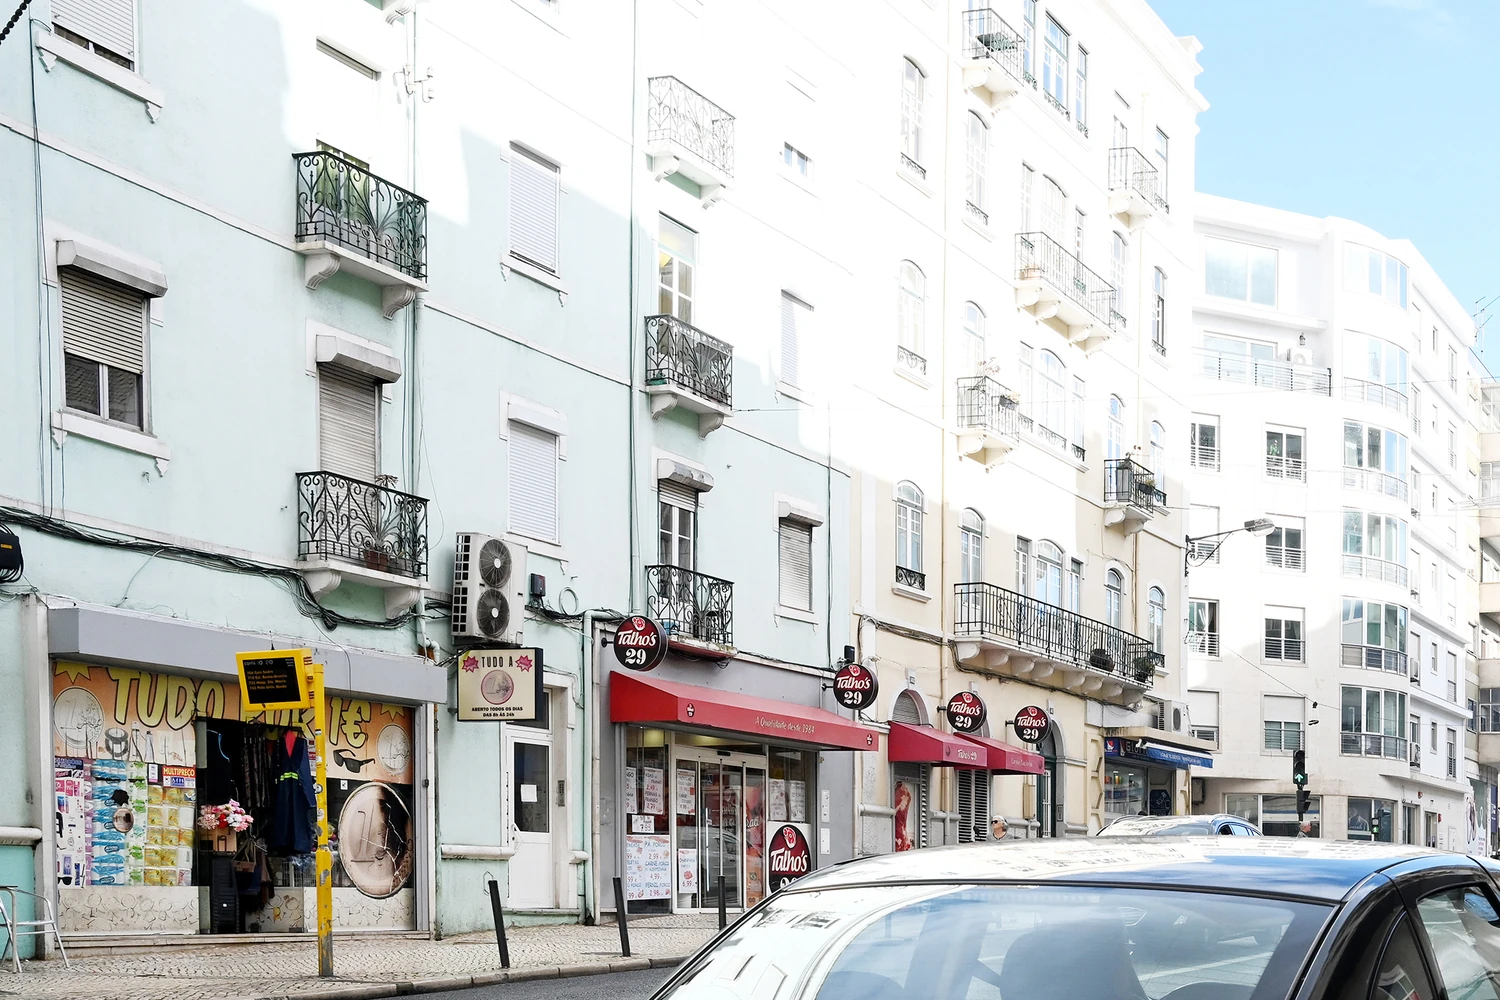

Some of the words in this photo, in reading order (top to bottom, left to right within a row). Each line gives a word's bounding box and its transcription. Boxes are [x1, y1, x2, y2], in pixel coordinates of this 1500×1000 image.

[618, 629, 657, 647] Talho's
[481, 656, 504, 668] TUDO
[508, 656, 513, 668] A
[625, 648, 647, 665] 29
[836, 675, 871, 691] Talho's
[107, 667, 225, 731] TUDO
[844, 691, 863, 705] 29
[950, 701, 982, 716] Talho's
[760, 717, 787, 730] Qualidade
[787, 723, 801, 732] desde
[955, 715, 972, 728] 29
[1016, 716, 1046, 728] Talho's
[1023, 728, 1039, 740] 29
[163, 767, 195, 777] MULTIPREÇO
[771, 847, 808, 872] Talho's
